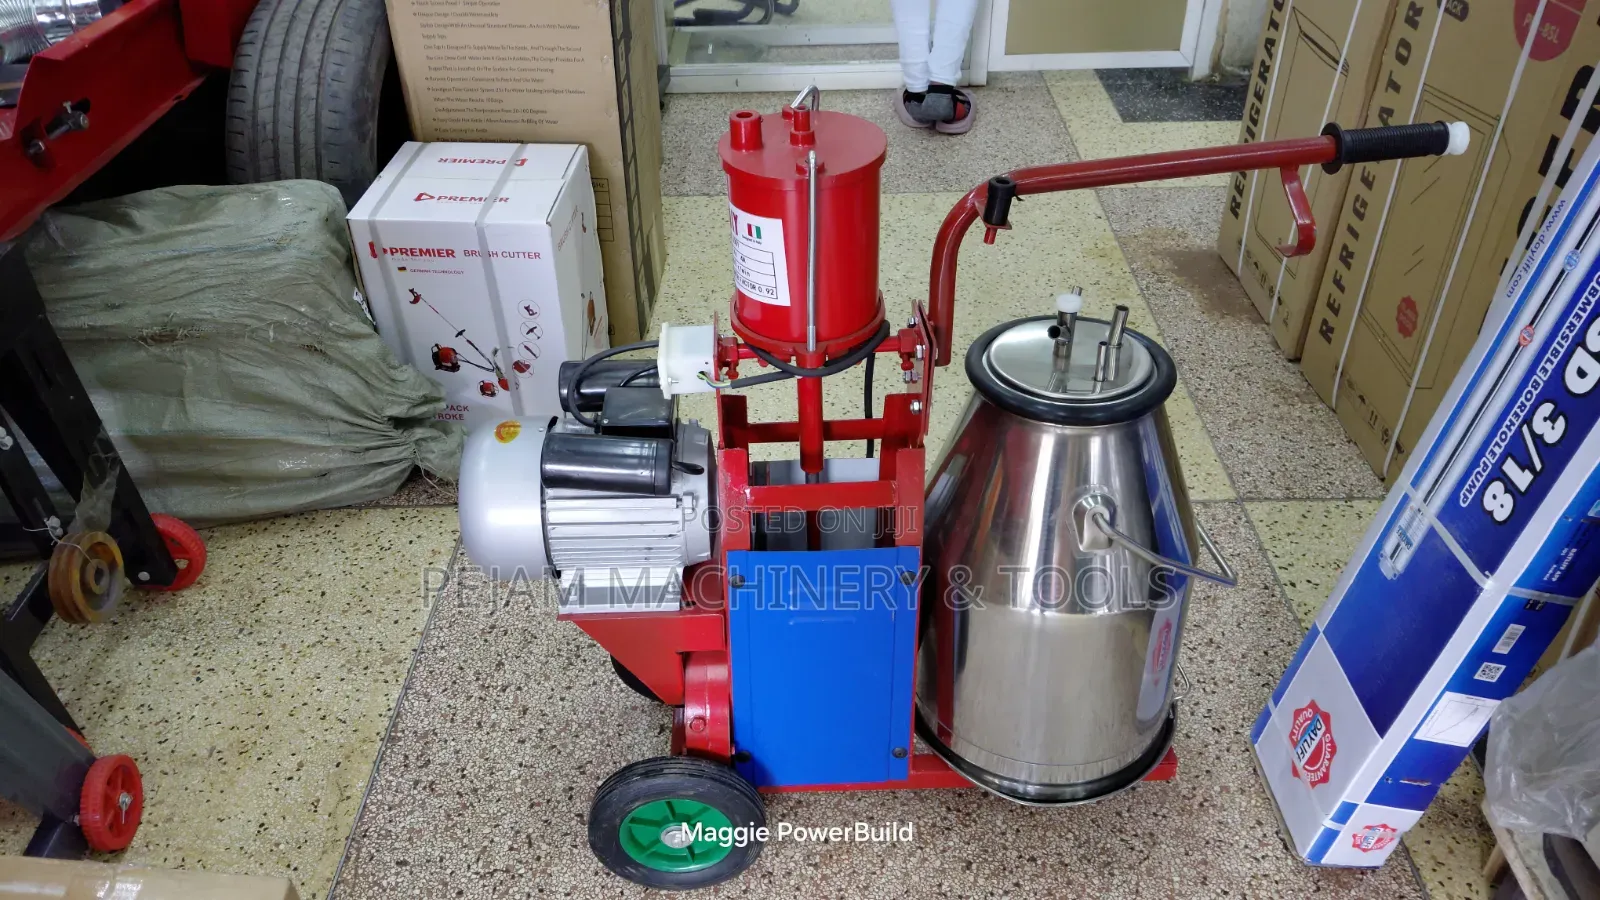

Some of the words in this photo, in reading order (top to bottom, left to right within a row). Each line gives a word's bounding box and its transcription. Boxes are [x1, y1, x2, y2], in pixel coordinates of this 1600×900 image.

[1318, 0, 1424, 344] REFRIGEATOR
[390, 247, 456, 258] PREMIER
[501, 250, 541, 259] CUTTER
[1507, 200, 1566, 298] www.dayliff.com
[1482, 402, 1566, 523] 3/18
[1489, 376, 1544, 464] BOREHOLE
[1460, 457, 1492, 507] PUMP
[1292, 708, 1314, 742] QUALITY
